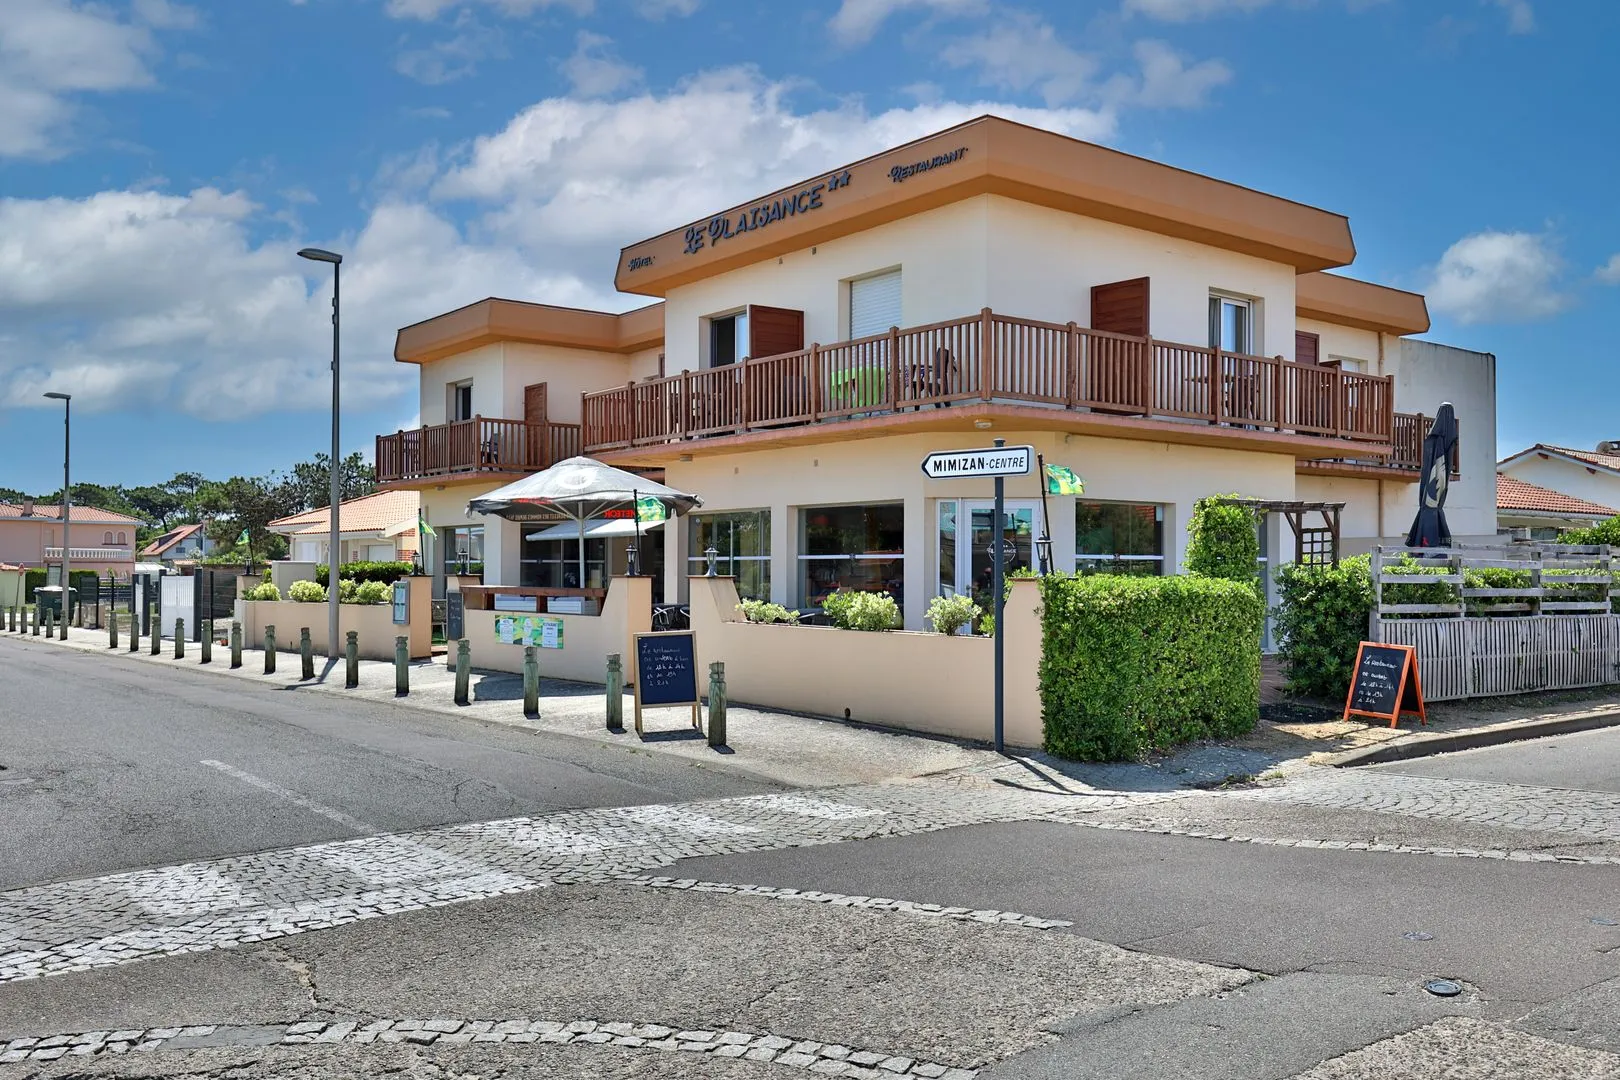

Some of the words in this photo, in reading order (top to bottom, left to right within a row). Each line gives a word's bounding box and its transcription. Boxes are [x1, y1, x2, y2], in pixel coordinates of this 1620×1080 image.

[890, 147, 966, 182] RESTAURANT
[683, 225, 707, 254] LE
[708, 183, 825, 247] PLAISANCE
